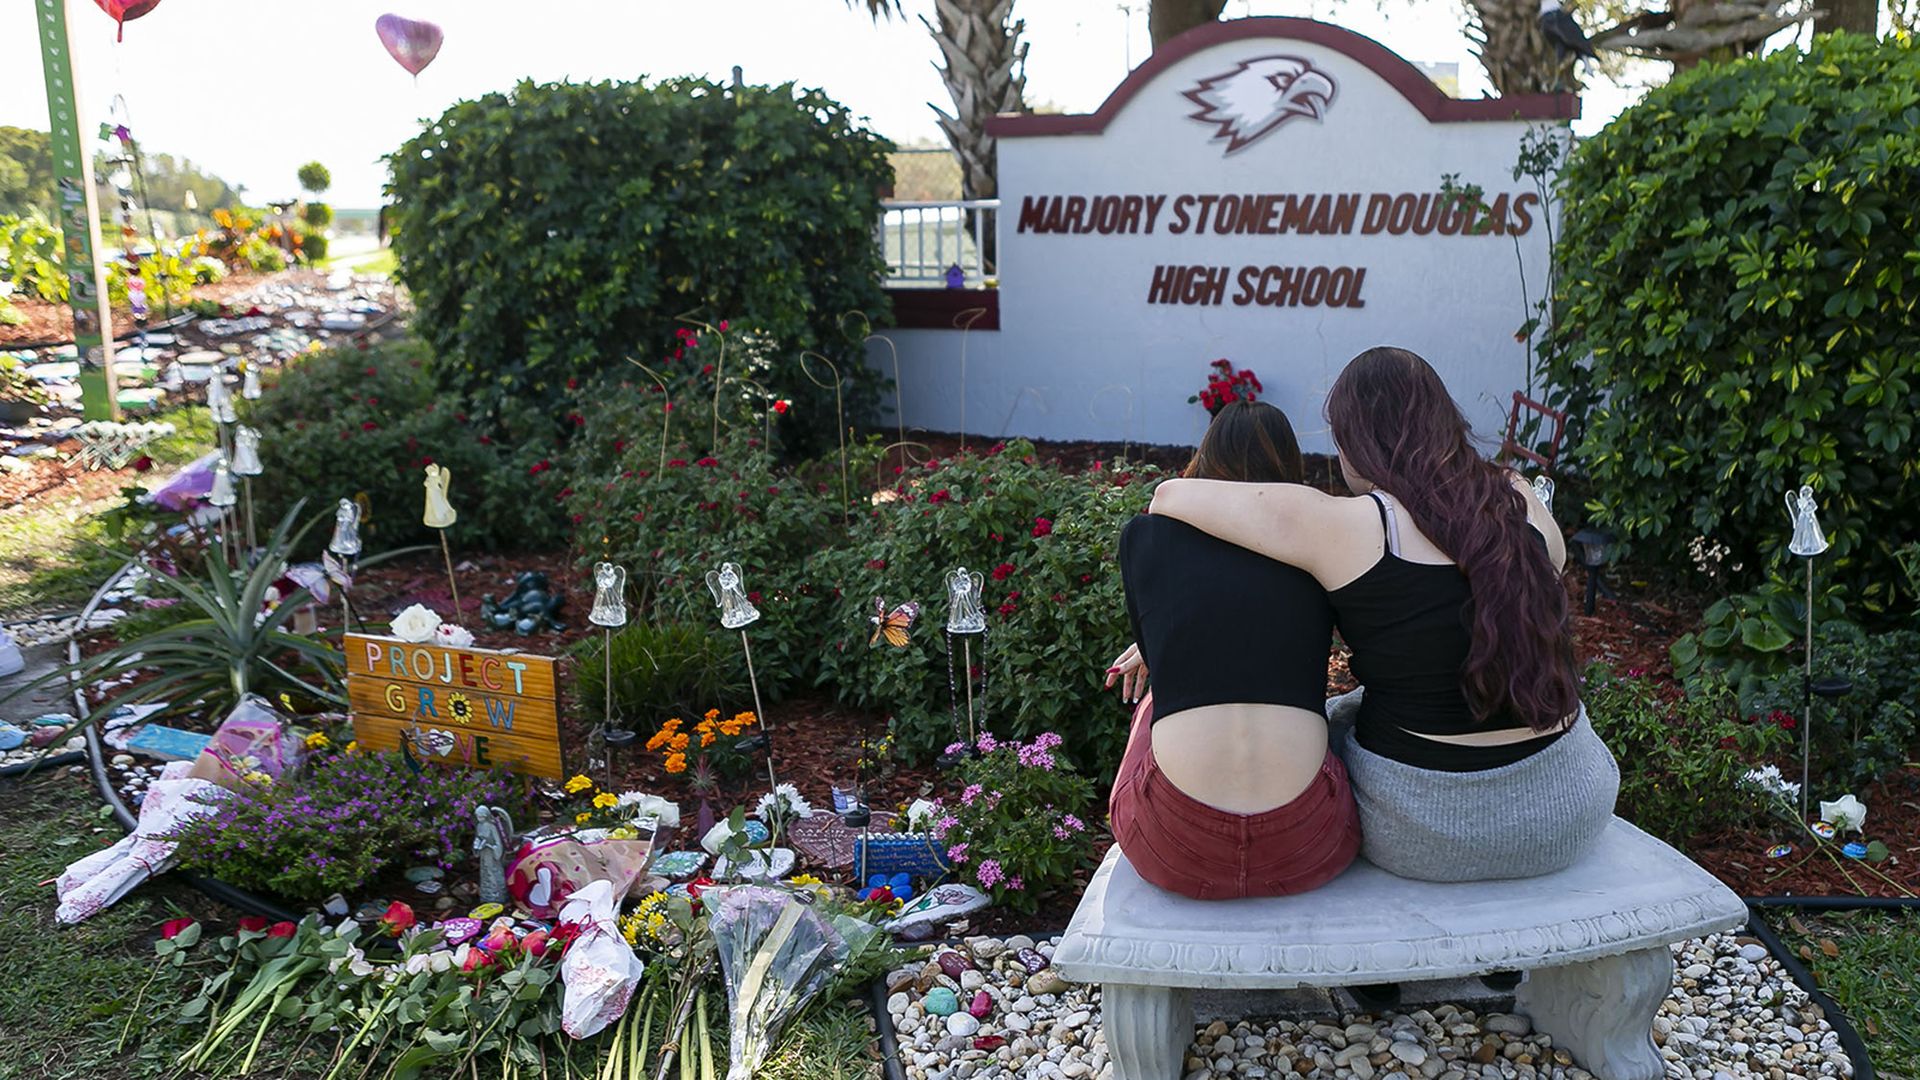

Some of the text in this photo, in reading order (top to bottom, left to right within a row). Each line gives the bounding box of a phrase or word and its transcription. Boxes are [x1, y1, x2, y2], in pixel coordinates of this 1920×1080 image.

[1018, 192, 1540, 236] MARJORY STONEMAN DOUGLAS
[1147, 265, 1367, 308] HIGH SCHOOL
[366, 641, 527, 695] PROJECT
